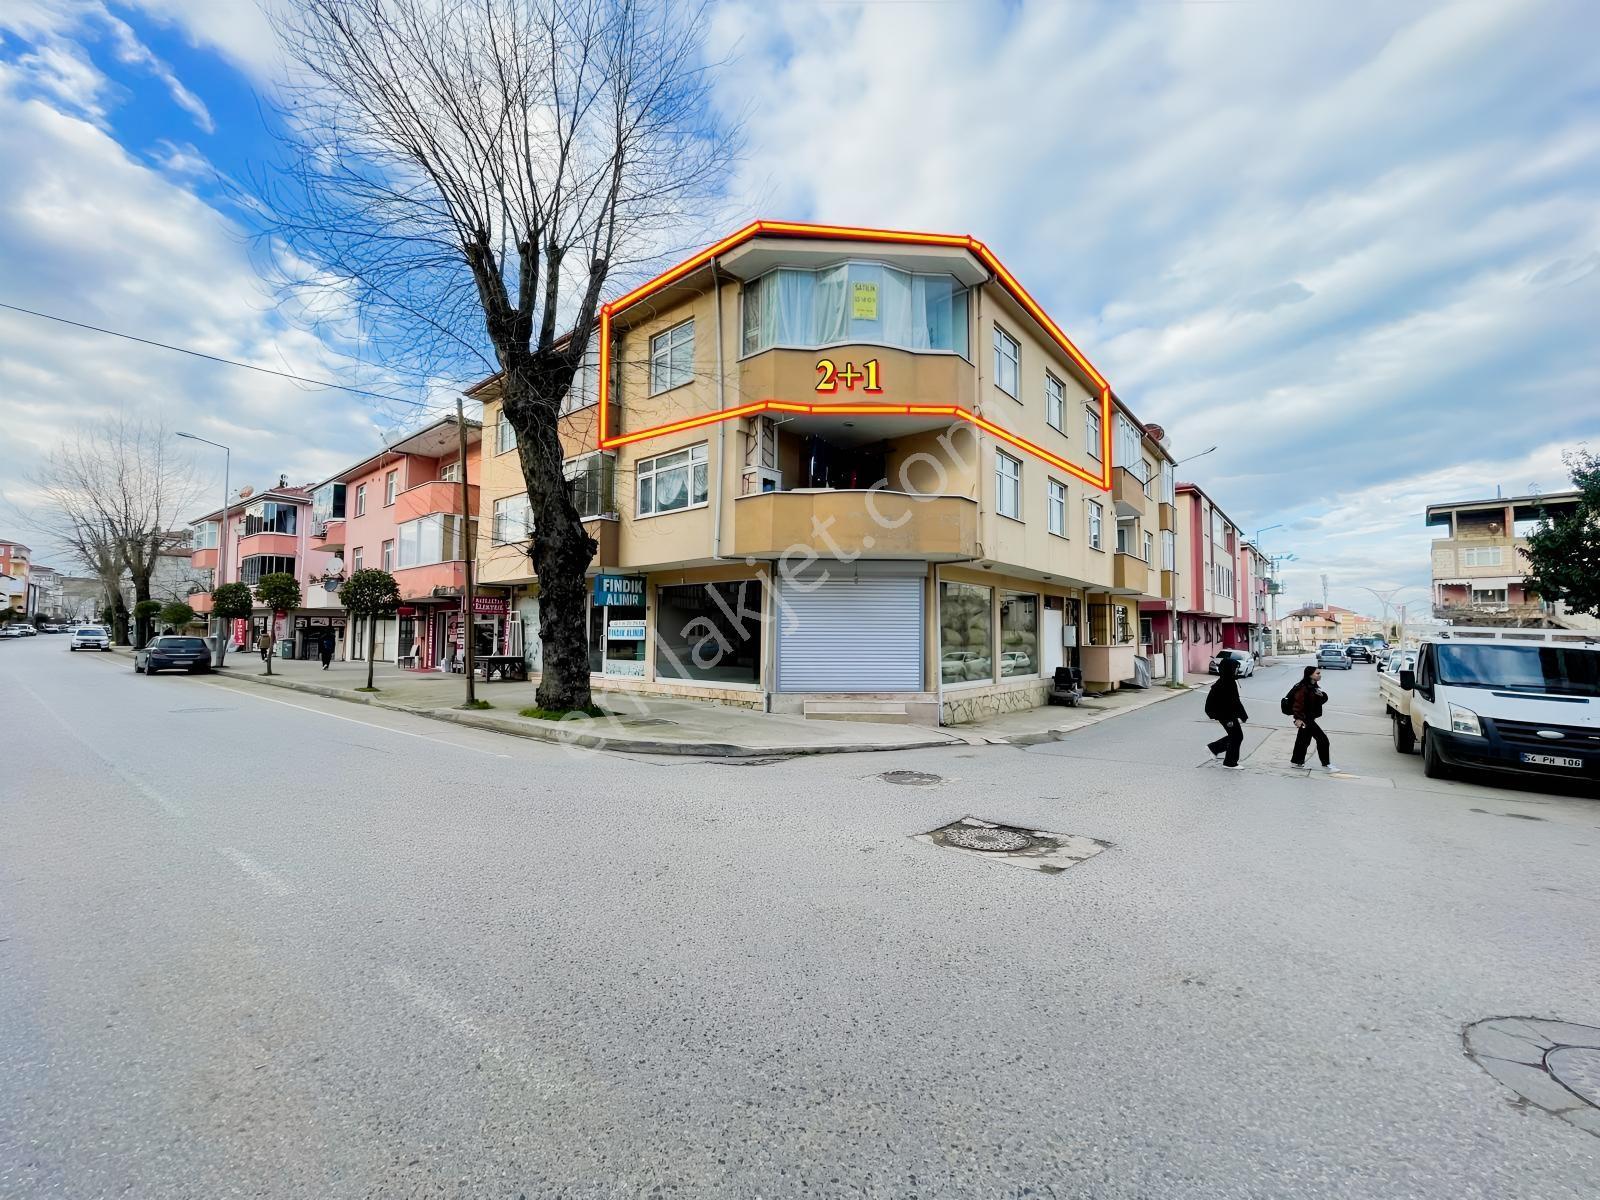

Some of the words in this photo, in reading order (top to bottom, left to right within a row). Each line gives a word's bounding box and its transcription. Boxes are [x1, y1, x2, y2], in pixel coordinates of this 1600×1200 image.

[603, 579, 643, 593] FINDIK
[606, 594, 639, 606] ALINIR
[1543, 756, 1555, 765] PH
